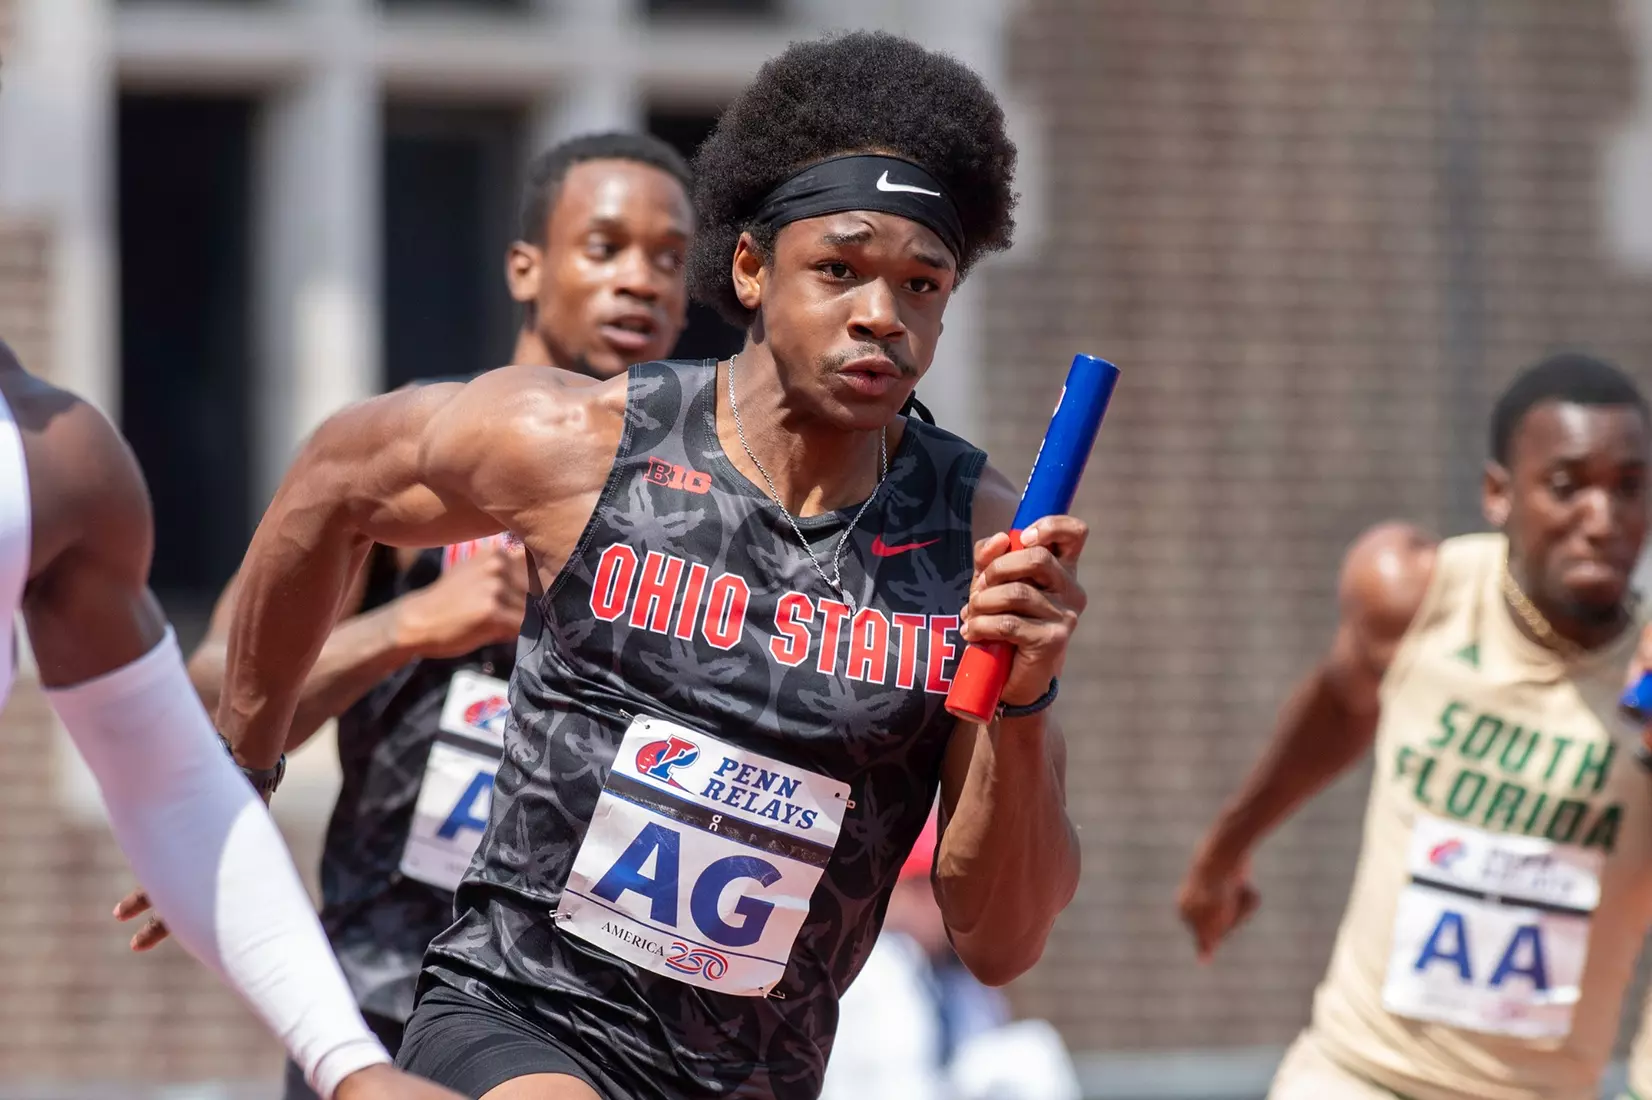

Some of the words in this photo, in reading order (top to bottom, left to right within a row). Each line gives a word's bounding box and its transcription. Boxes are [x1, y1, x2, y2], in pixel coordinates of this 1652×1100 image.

[590, 543, 750, 650] OHIO
[769, 590, 959, 695] STATE
[713, 757, 802, 798] PENN
[1428, 701, 1619, 794] SOUTH
[700, 778, 818, 830] RELAYS
[1394, 747, 1625, 850] FLORIDA
[590, 821, 783, 947] AG
[601, 921, 665, 957] AMERICA
[665, 942, 728, 982] 250
[1414, 911, 1550, 991] AA
